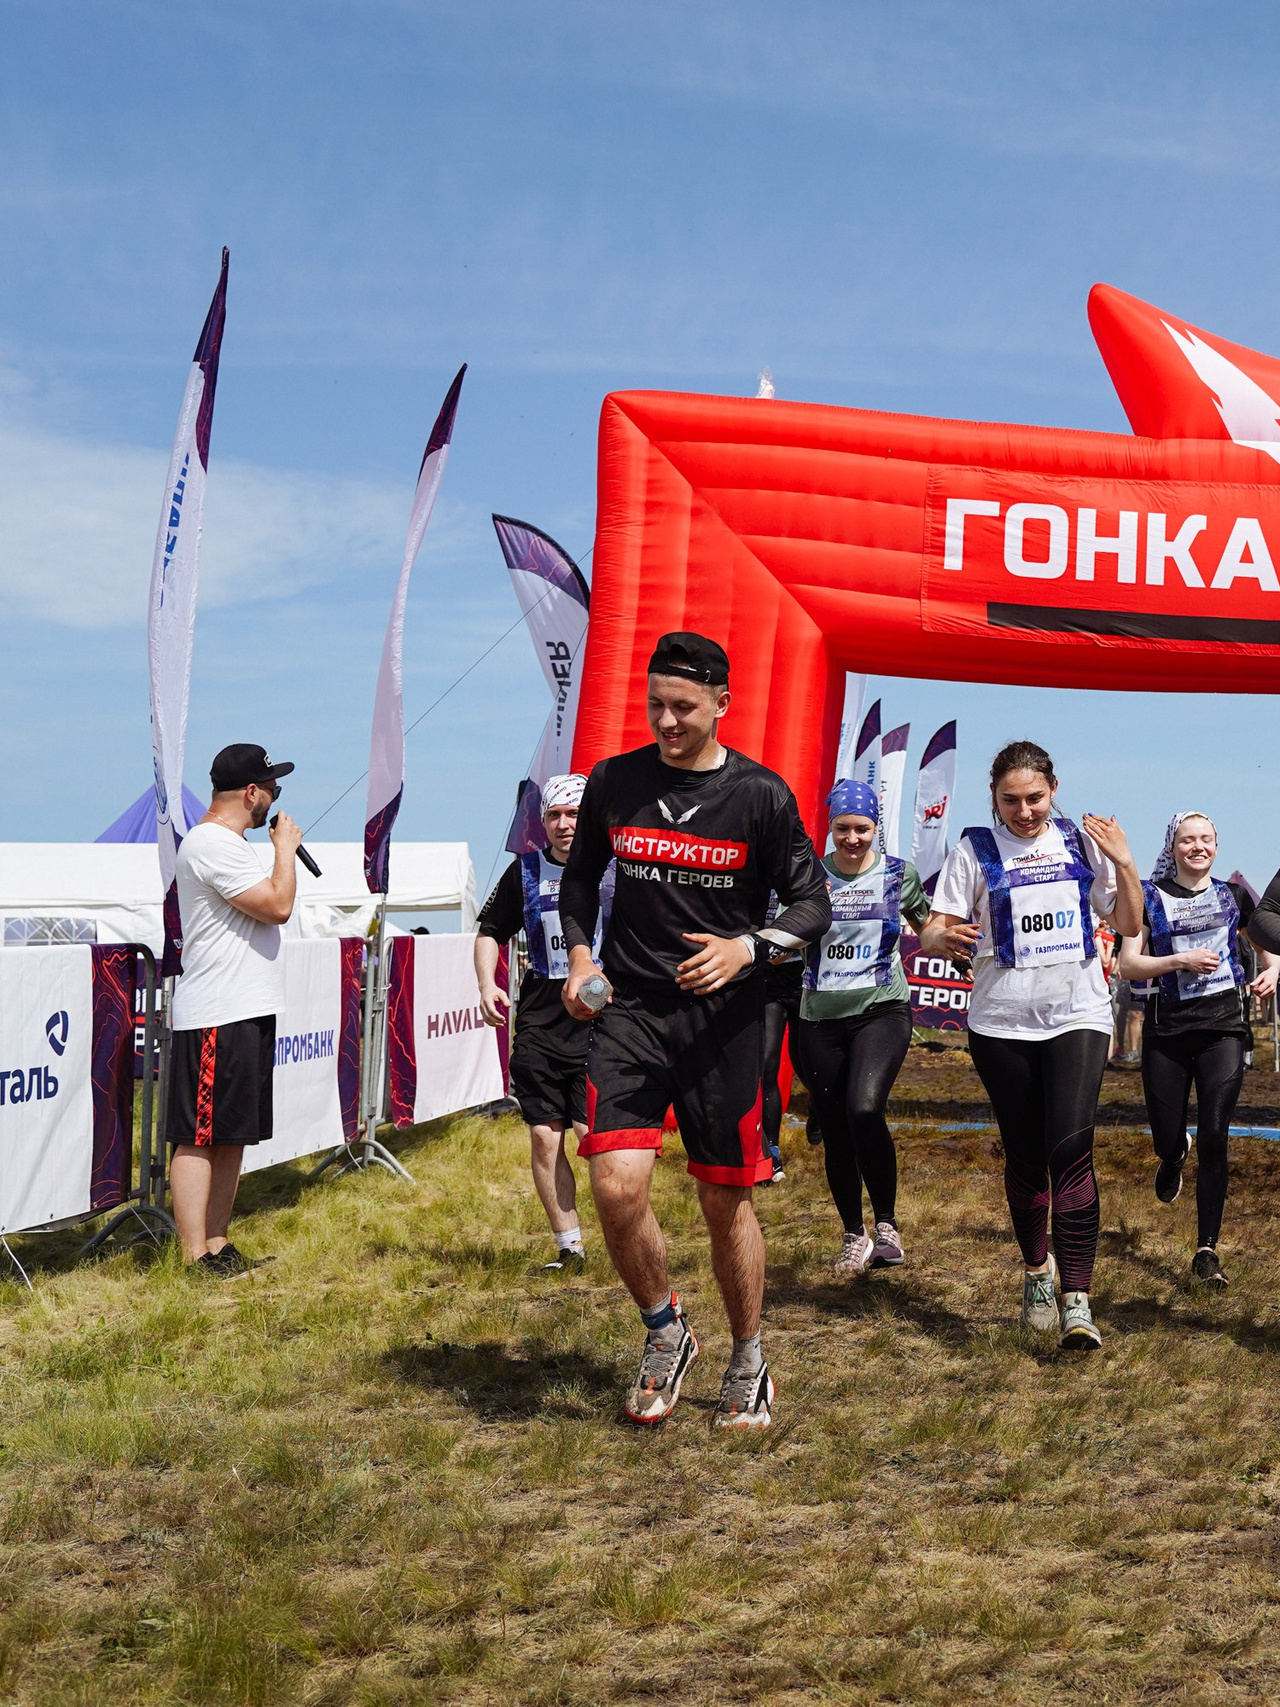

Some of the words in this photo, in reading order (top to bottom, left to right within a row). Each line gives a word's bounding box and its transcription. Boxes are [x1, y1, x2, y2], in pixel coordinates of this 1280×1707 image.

[943, 497, 1280, 592] ГОНКА
[612, 833, 739, 865] ИНСТРУКТОР
[667, 869, 734, 889] ГЕРОЕВ
[1020, 863, 1067, 876] КОМАНДНЫЙ
[1034, 873, 1056, 882] СТАРТ
[1021, 910, 1075, 934] 08007
[827, 944, 872, 960] 08010
[1035, 942, 1081, 954] ГАЗПРОМБАНК
[909, 985, 971, 1011] ГЕРО
[427, 1006, 485, 1039] HAVAL
